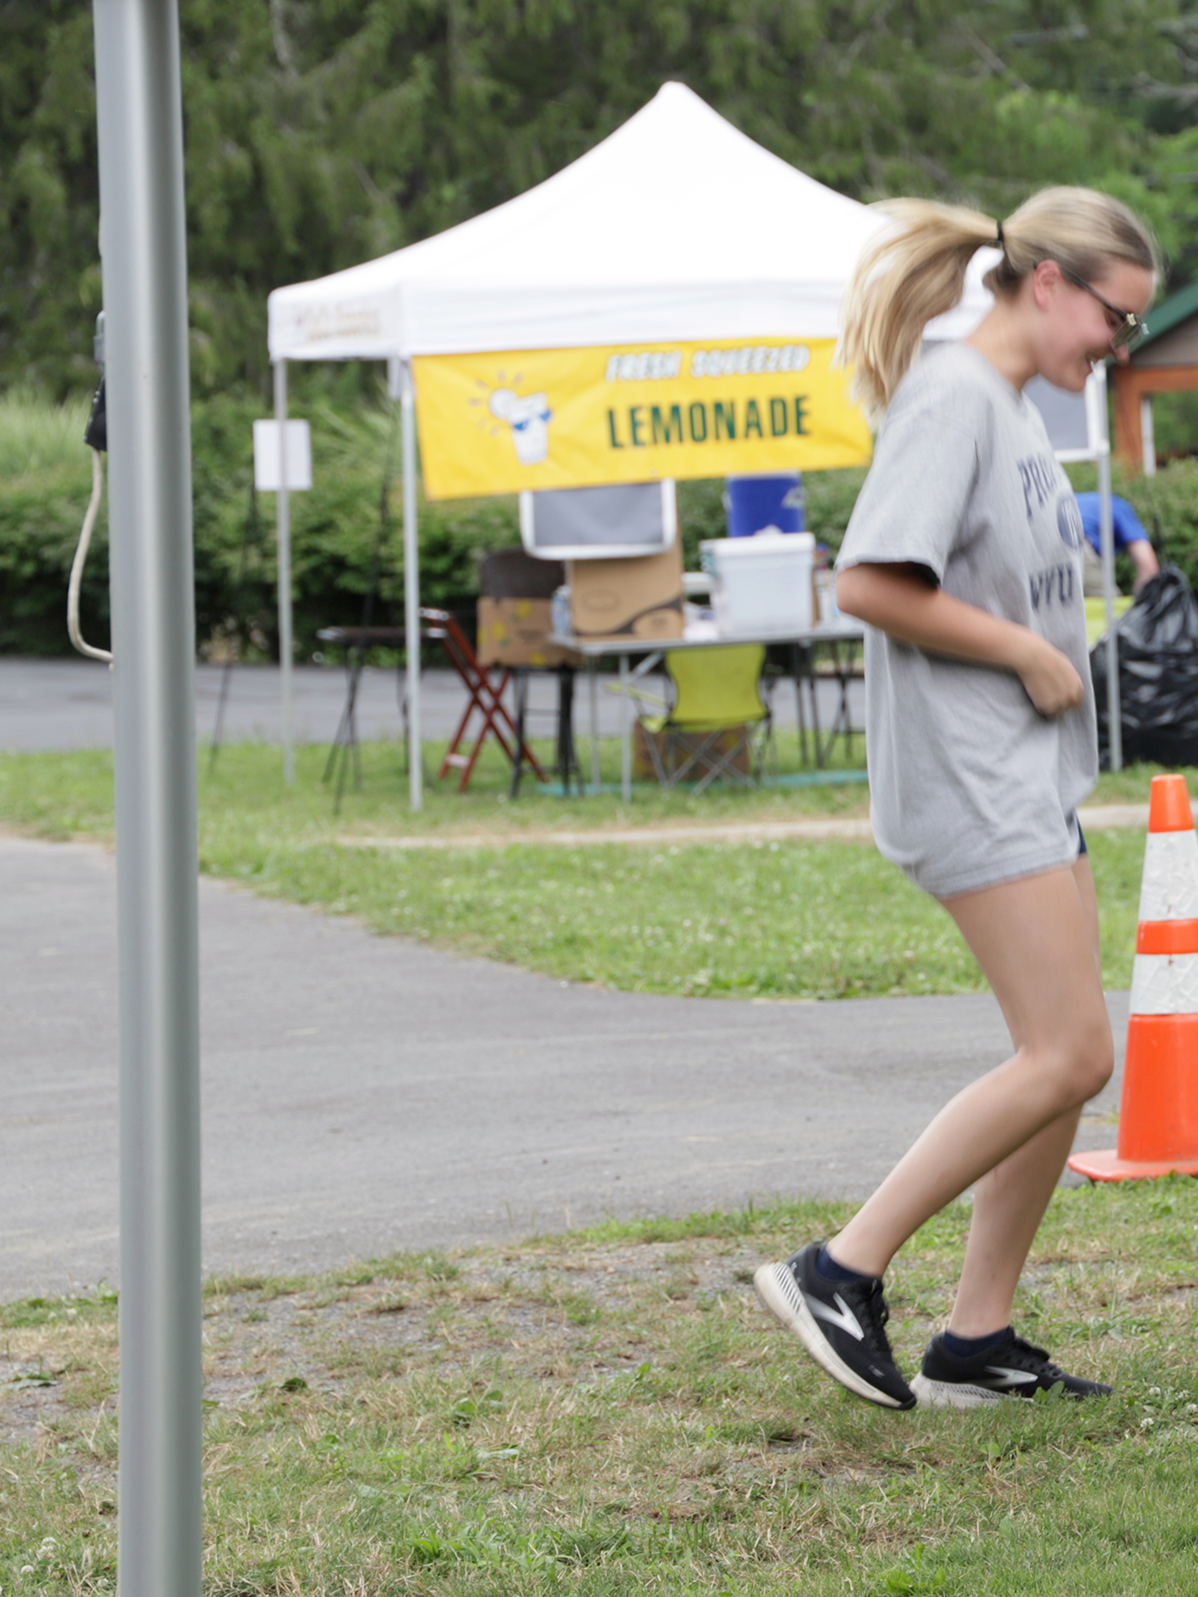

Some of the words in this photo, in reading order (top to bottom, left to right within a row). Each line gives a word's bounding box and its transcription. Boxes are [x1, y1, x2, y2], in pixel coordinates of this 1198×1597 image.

[606, 352, 681, 381] FRESH
[691, 345, 810, 378] SQUEEZED
[607, 394, 811, 449] LEMONADE
